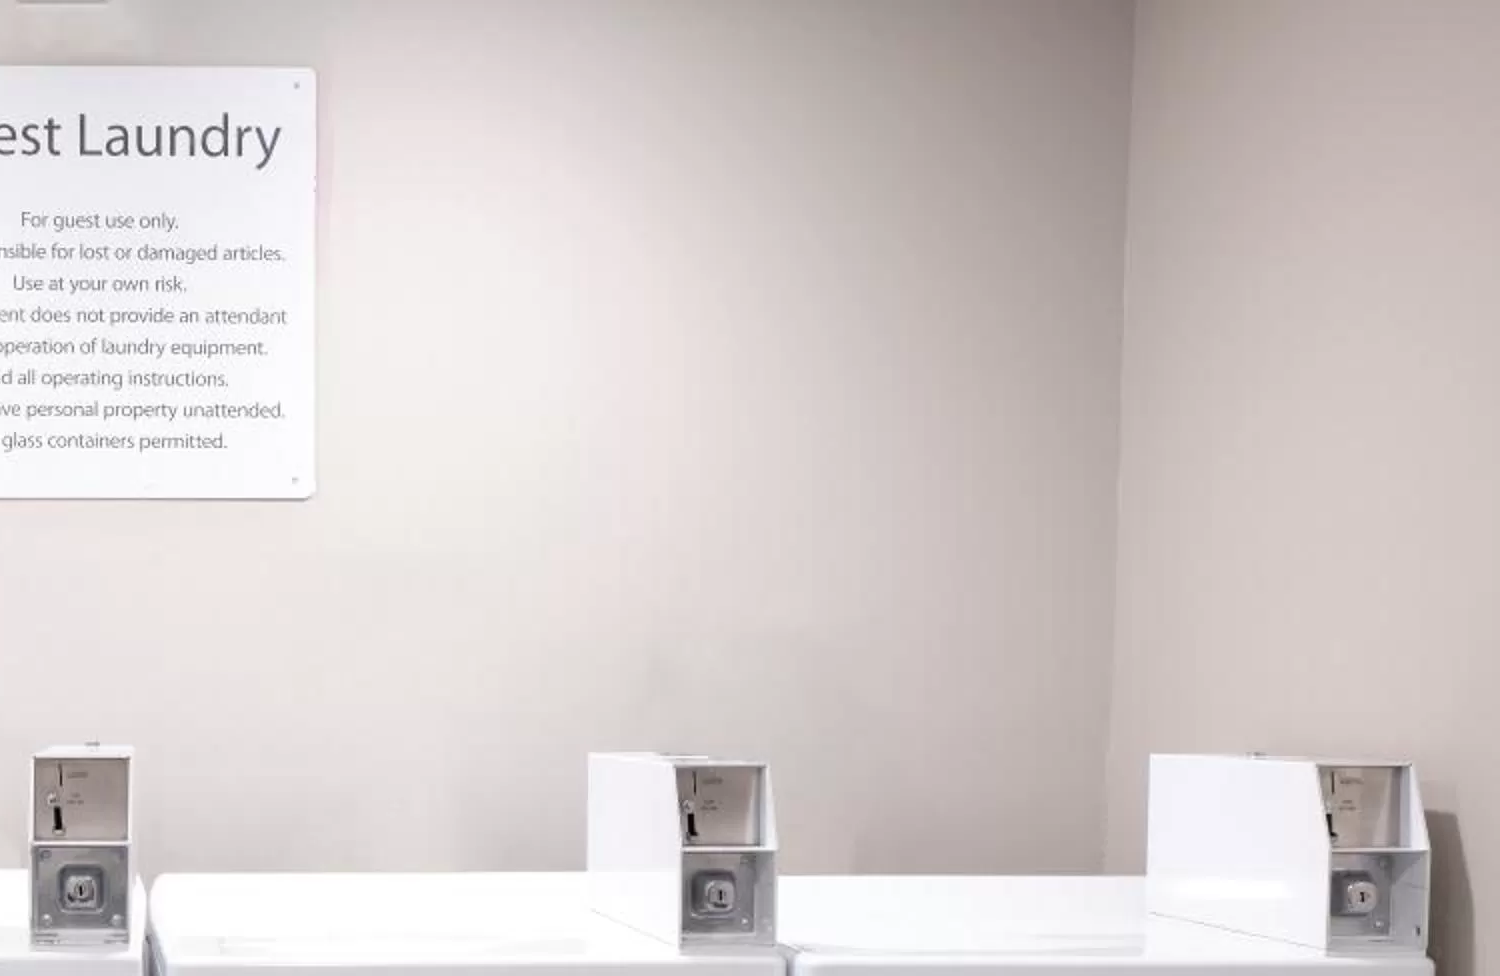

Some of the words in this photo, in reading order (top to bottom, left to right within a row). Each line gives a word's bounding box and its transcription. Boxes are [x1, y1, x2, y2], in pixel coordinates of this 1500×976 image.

[78, 111, 282, 171] Laundry
[20, 211, 50, 229] For
[52, 213, 101, 233] guest
[105, 215, 136, 230] use
[139, 211, 179, 233] only.
[51, 242, 75, 260] for
[79, 243, 110, 261] lost
[113, 247, 133, 261] or
[136, 243, 218, 264] damaged
[222, 243, 285, 262] articles.
[13, 273, 45, 292] Use
[47, 276, 65, 292] at
[69, 279, 108, 295] your
[111, 279, 149, 293] own
[154, 275, 187, 293] risk.
[29, 305, 72, 324] does
[76, 308, 106, 324] not
[109, 307, 175, 326] provide
[179, 311, 200, 324] an
[204, 307, 287, 325] attendant
[79, 336, 98, 355] of
[101, 337, 167, 359] laundry
[170, 339, 269, 359] equipment.
[17, 368, 36, 385] all
[40, 370, 123, 390] operating
[128, 370, 229, 387] instructions.
[25, 400, 99, 421] personal
[103, 403, 178, 422] property
[183, 401, 285, 420] unattended.
[1, 431, 43, 453] glass
[46, 432, 136, 449] containers
[139, 432, 228, 453] permitted.
